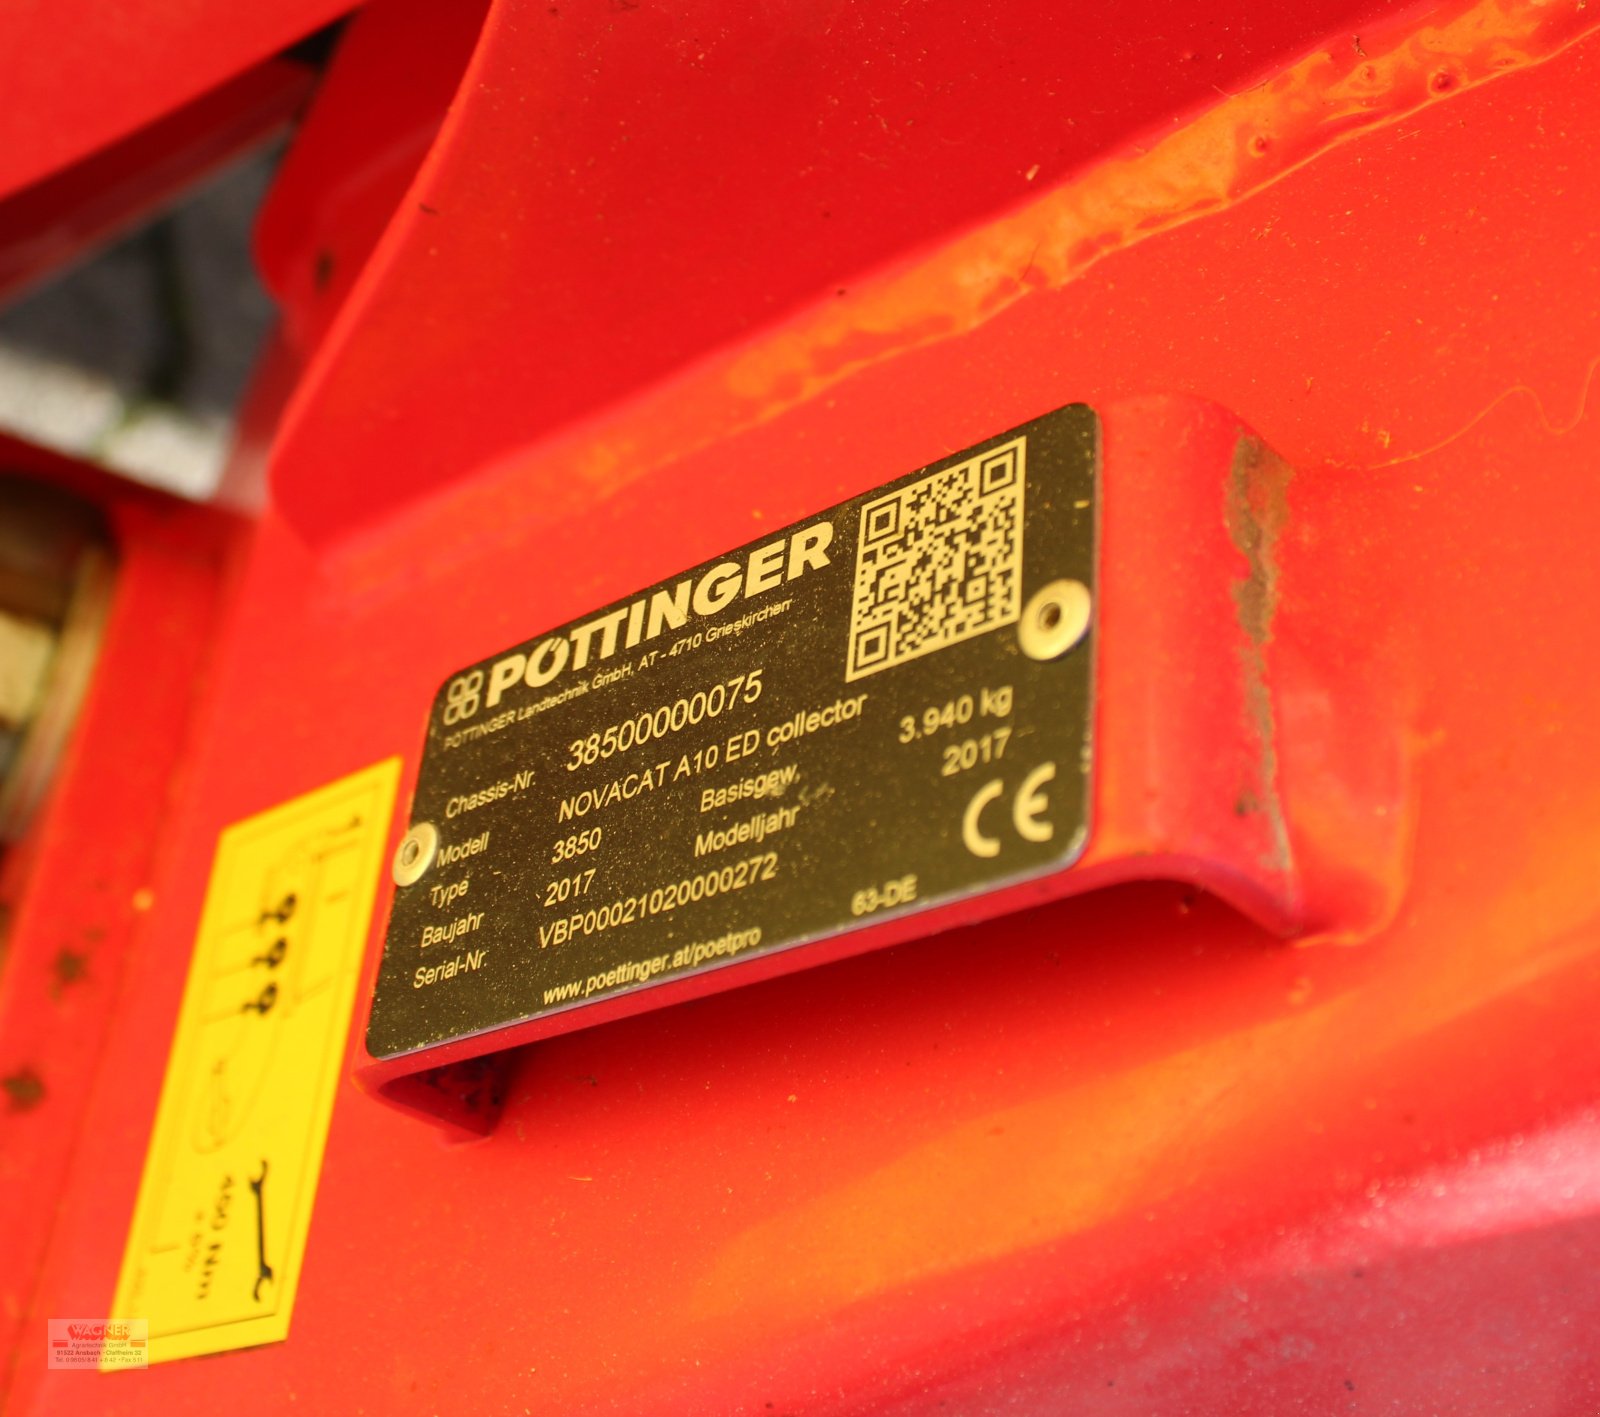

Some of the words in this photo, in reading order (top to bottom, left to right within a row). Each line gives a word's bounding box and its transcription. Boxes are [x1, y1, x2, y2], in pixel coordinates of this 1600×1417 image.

[518, 680, 589, 721] Landtechnik
[637, 651, 661, 671] AT
[669, 633, 702, 657] 4710
[705, 599, 793, 643] Grieskirchen
[431, 880, 469, 908] Type
[551, 827, 601, 864] 3850
[899, 695, 973, 743] 3.940
[980, 685, 1013, 717] kg
[436, 831, 490, 868] Modell
[558, 761, 671, 823] NOVACAT
[673, 745, 718, 781] A10
[726, 729, 760, 763] ED
[766, 694, 868, 746] collector
[445, 770, 536, 818] Chassis-Nr.
[566, 669, 763, 771] 38500000075
[420, 912, 485, 948] Baujahr
[544, 868, 596, 907] 2017
[694, 805, 801, 857] Modelljahr
[942, 726, 1012, 776] 2017
[851, 874, 918, 916] 63-DE
[413, 949, 488, 989] Serial-Nr.
[539, 852, 778, 948] VBP00021020000272
[543, 926, 762, 1005] www.poettinger.at/poetpro
